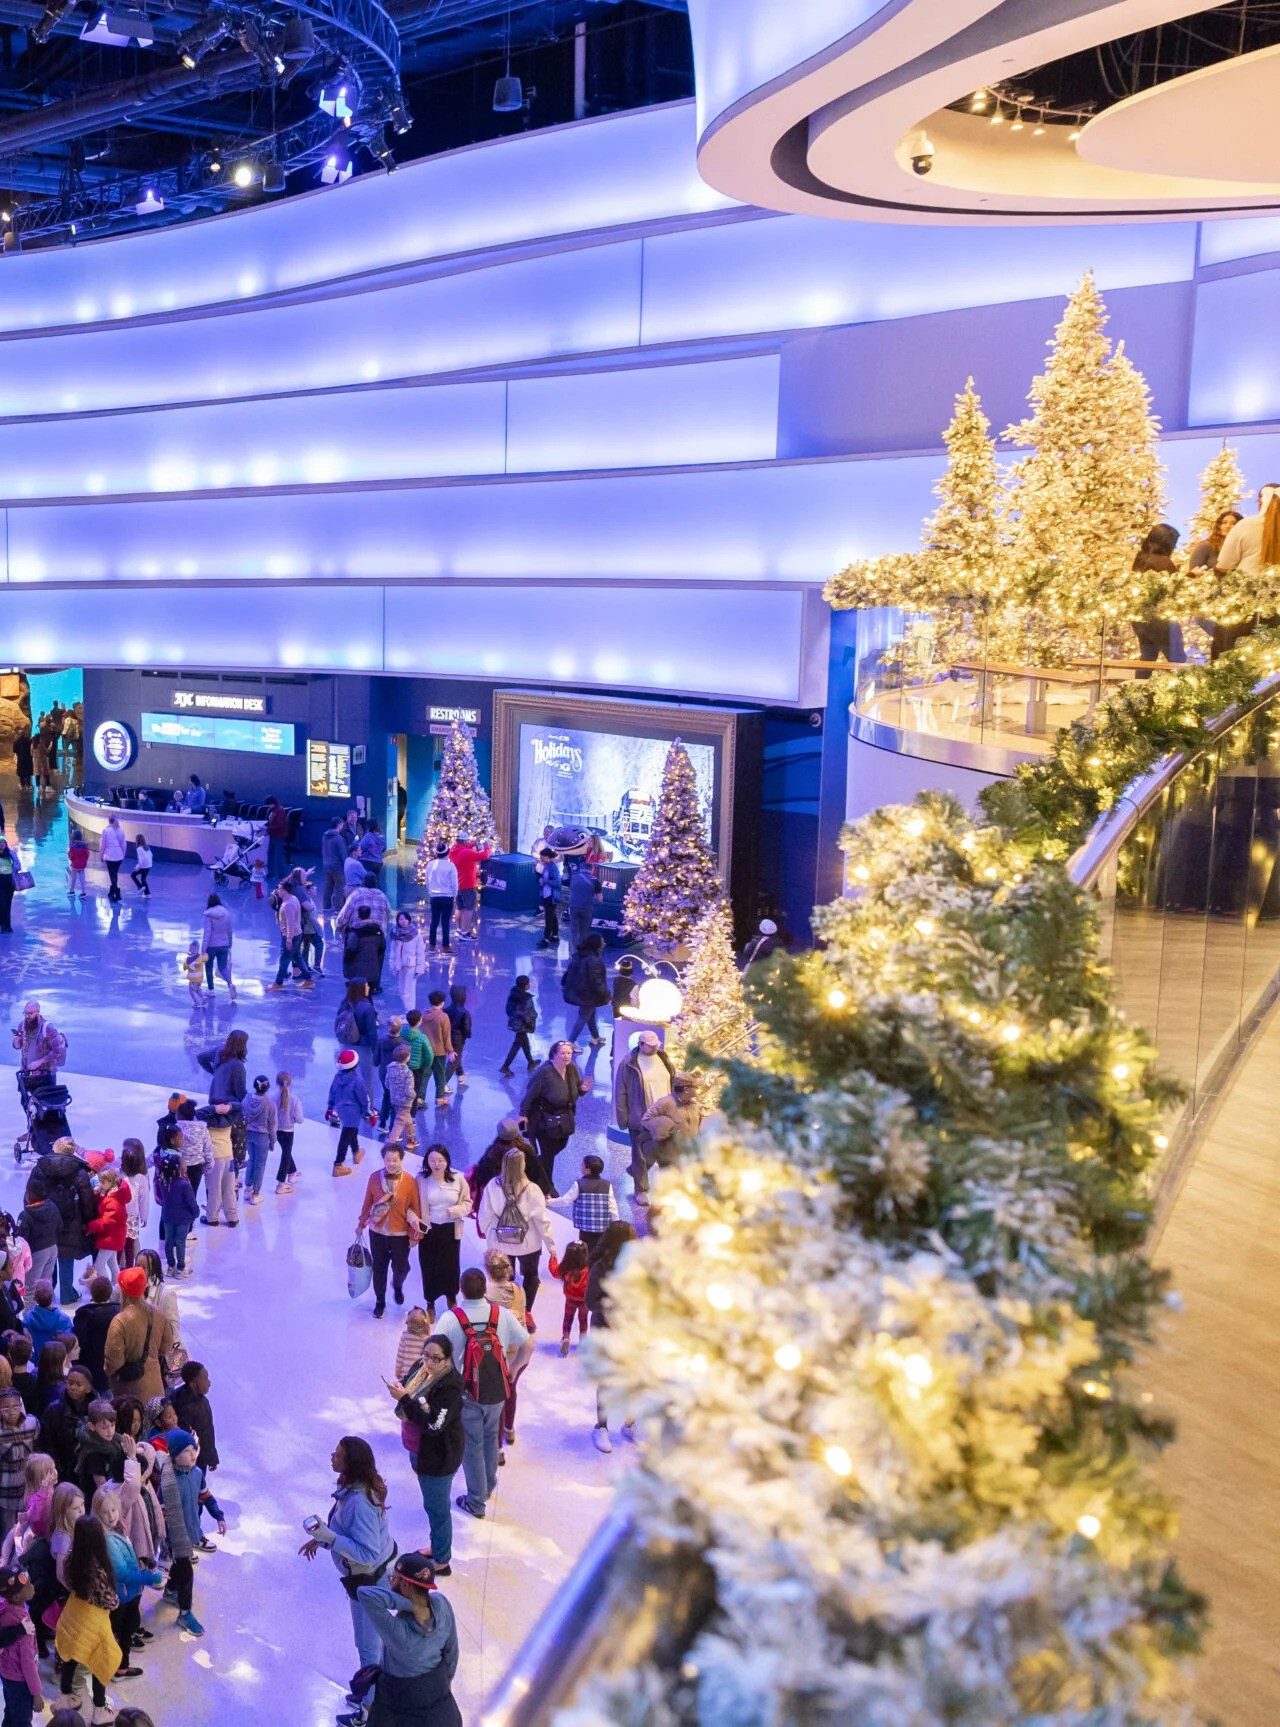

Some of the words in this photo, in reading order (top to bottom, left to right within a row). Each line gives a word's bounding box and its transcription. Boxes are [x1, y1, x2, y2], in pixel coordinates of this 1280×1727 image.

[195, 694, 243, 709] INFORMATION
[243, 698, 264, 711] DESK
[530, 738, 583, 772] Holidays
